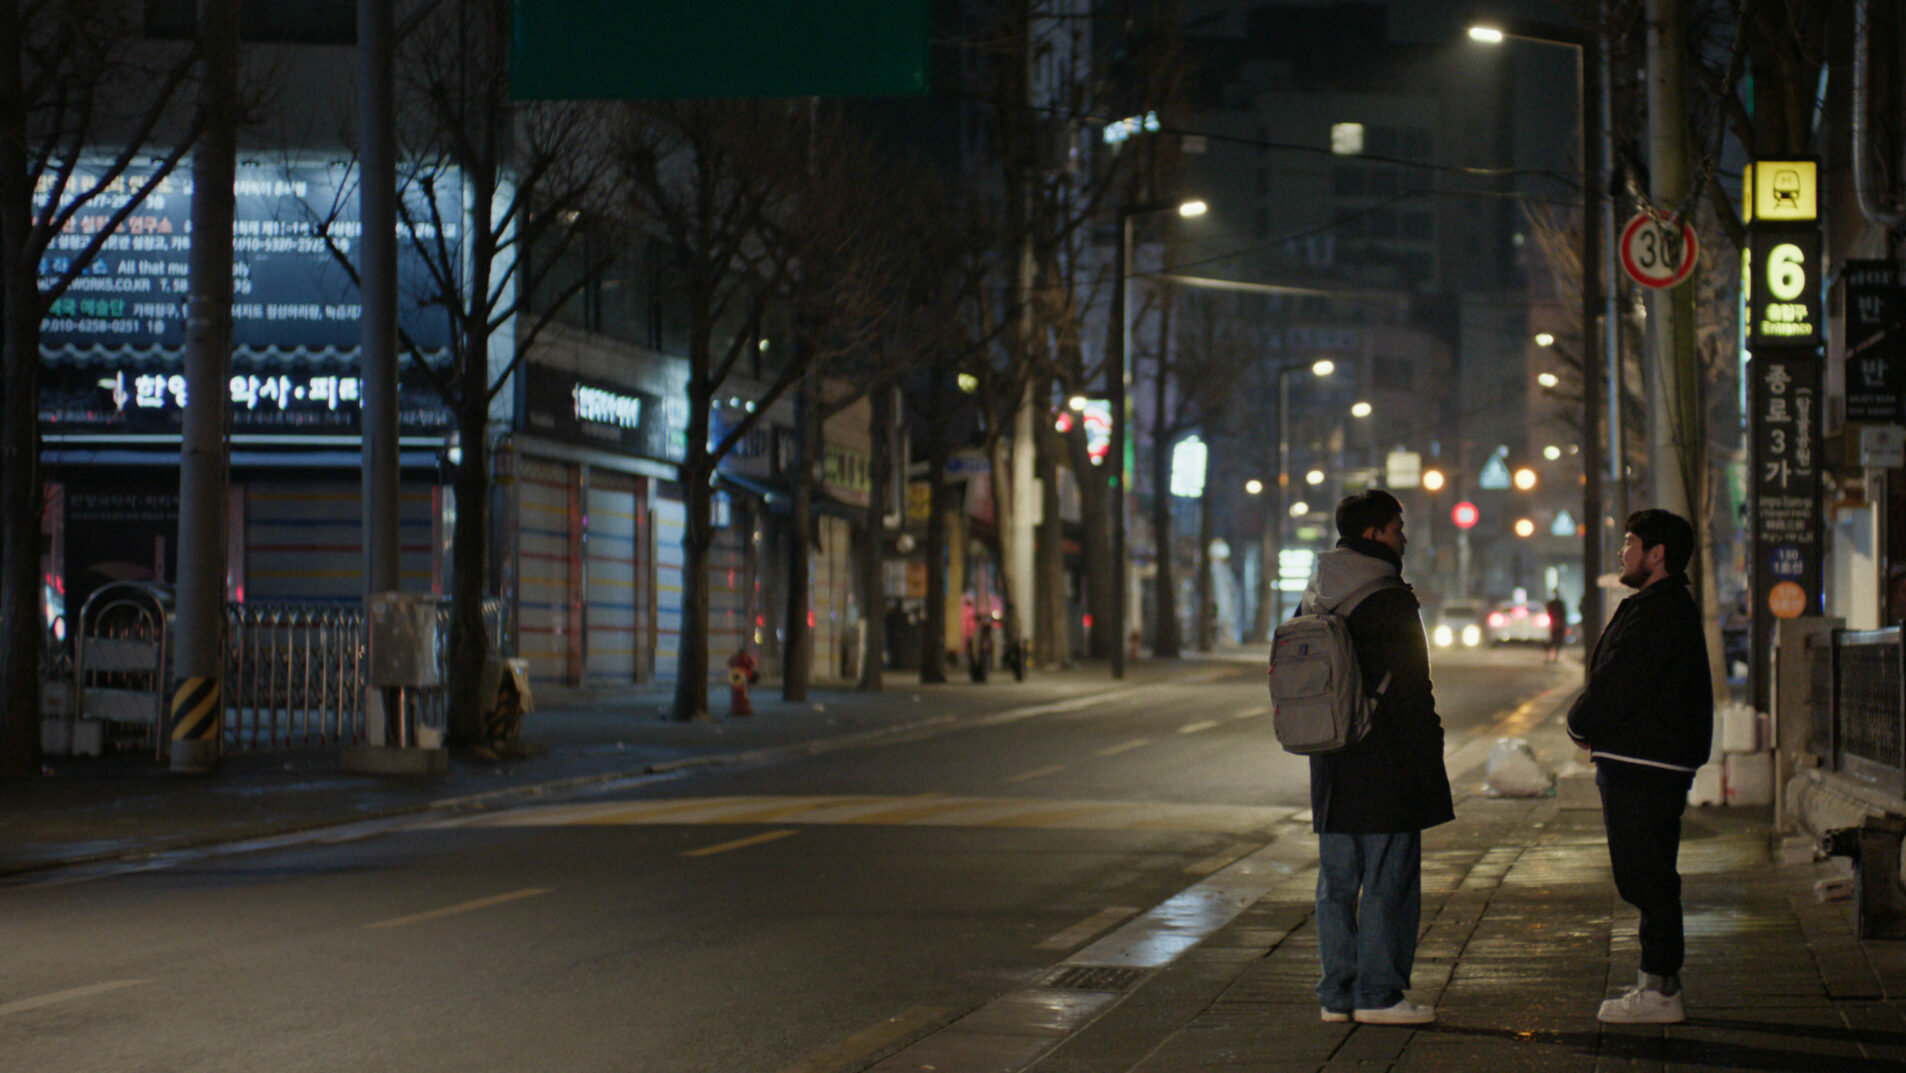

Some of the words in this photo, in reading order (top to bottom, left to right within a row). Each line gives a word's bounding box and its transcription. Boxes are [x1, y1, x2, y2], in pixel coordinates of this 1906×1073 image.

[117, 260, 135, 275] All
[138, 260, 165, 275] that
[168, 262, 190, 275] mu
[1767, 243, 1805, 300] 6
